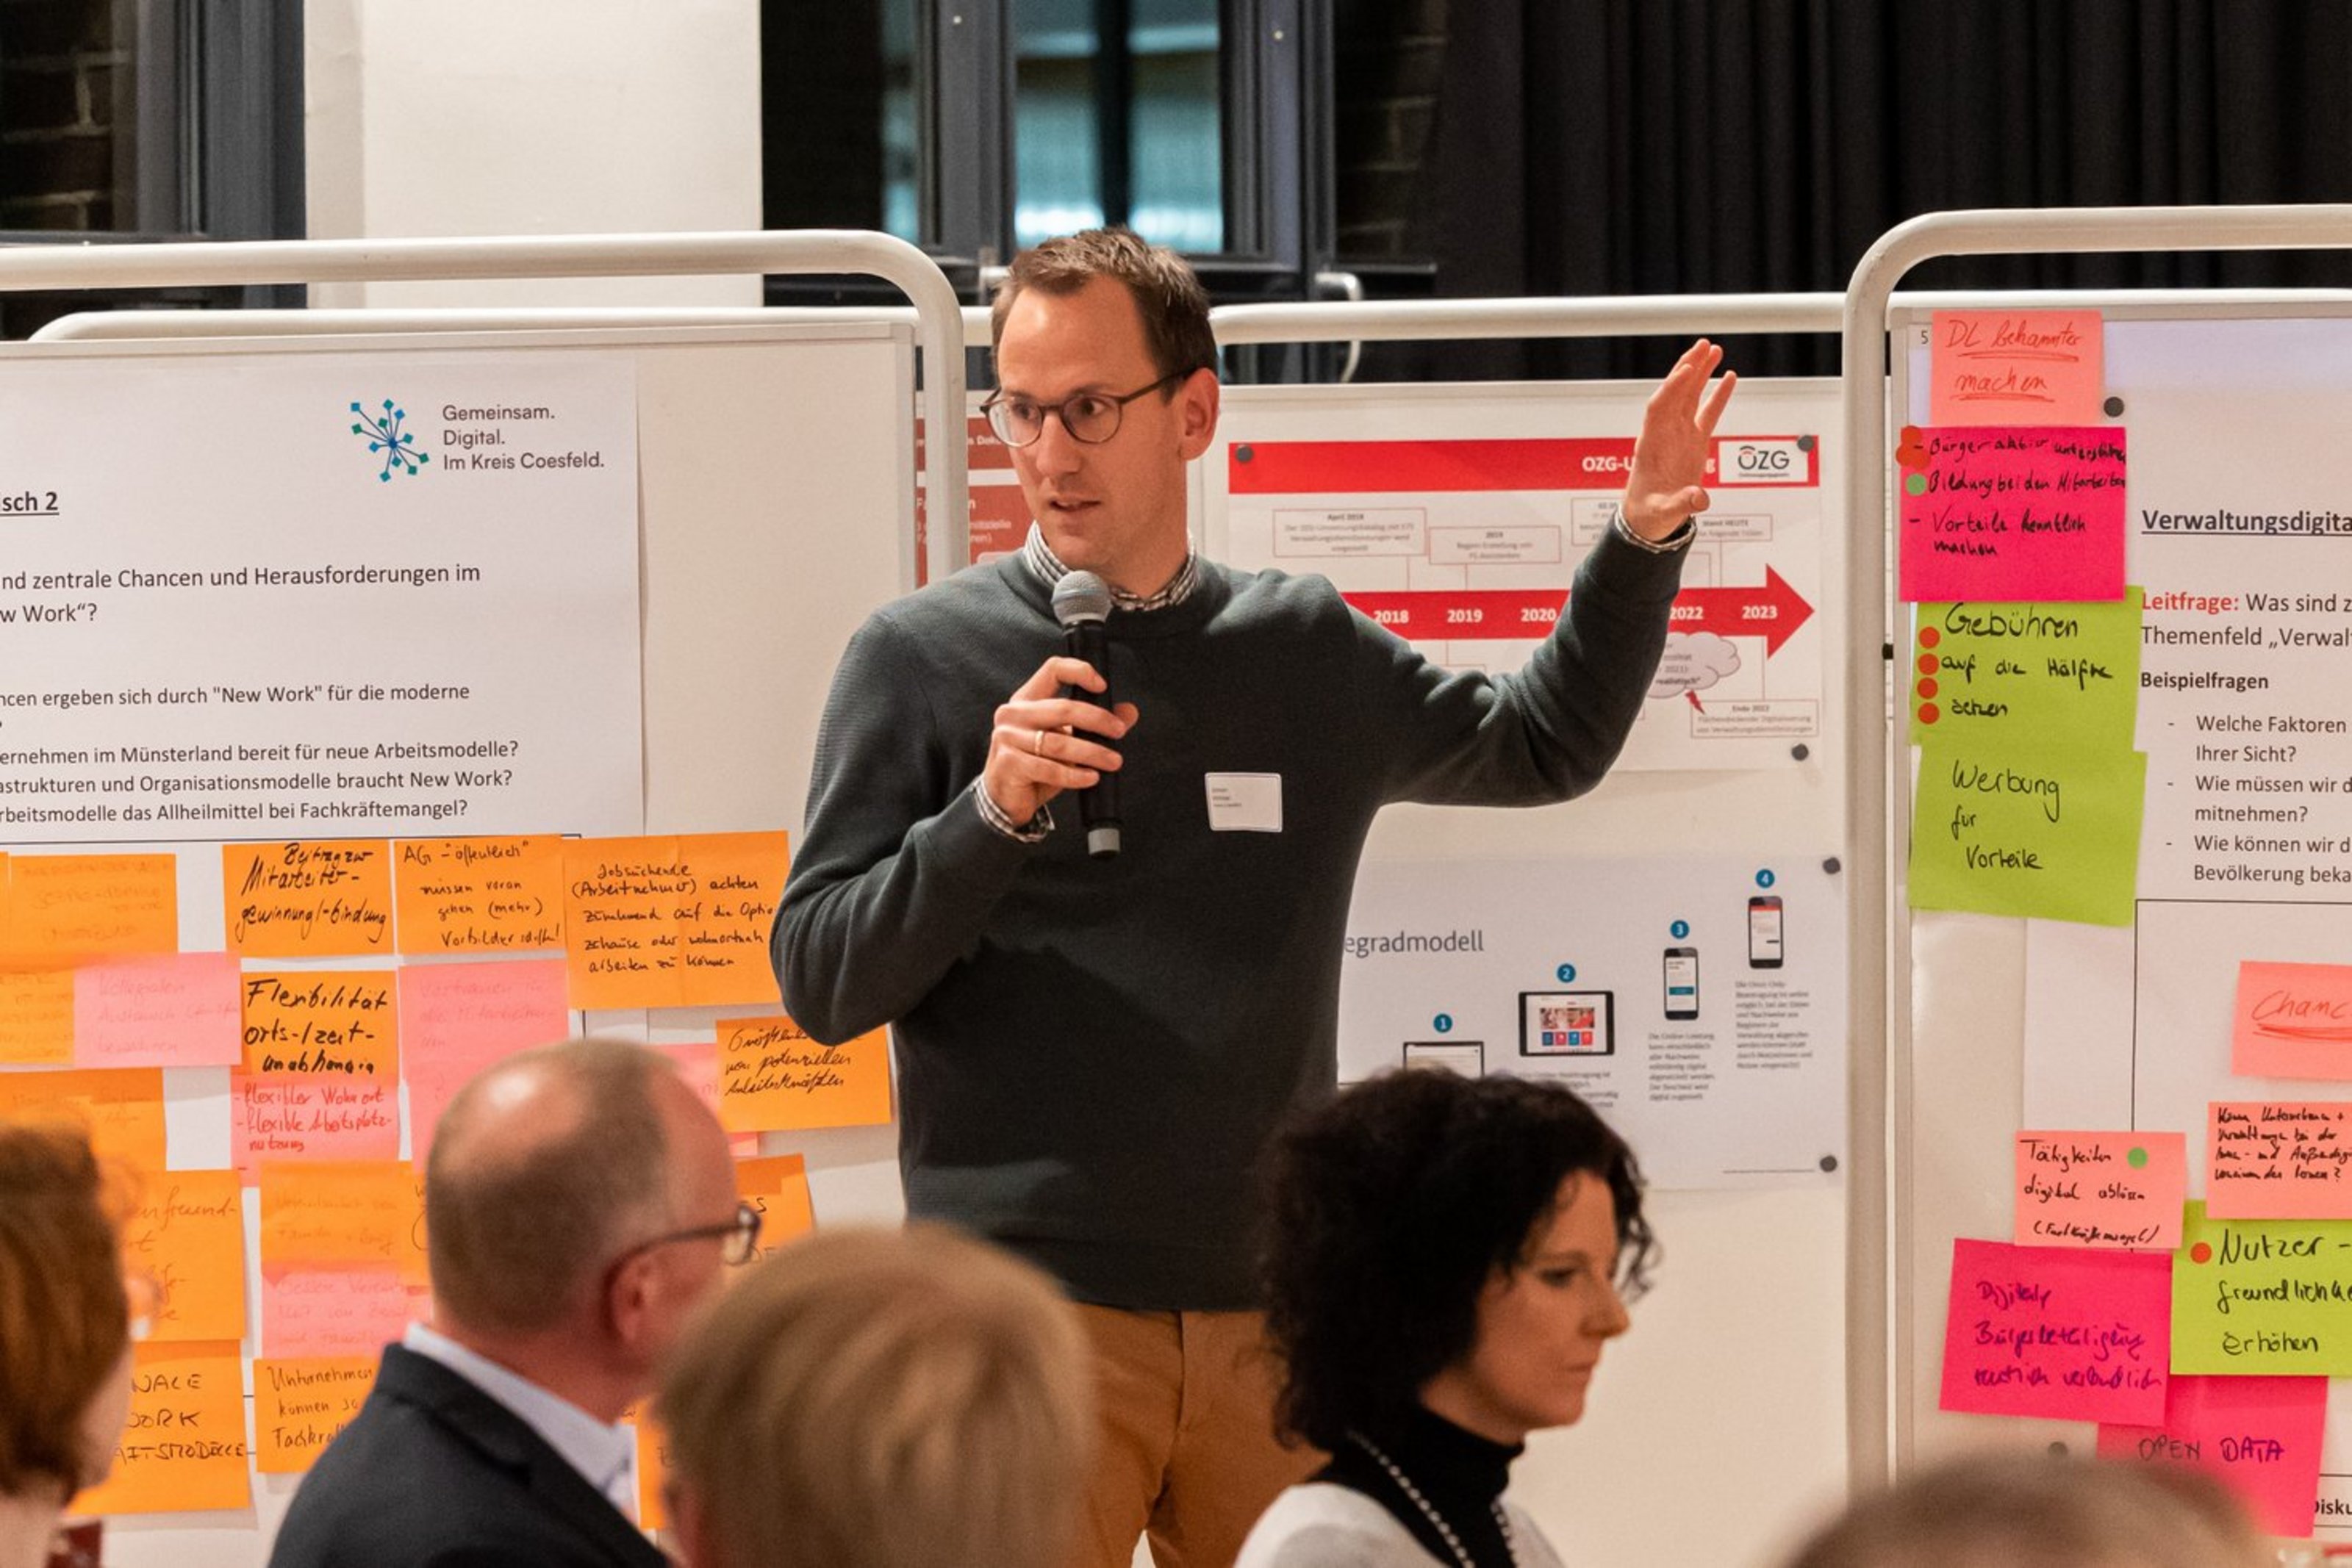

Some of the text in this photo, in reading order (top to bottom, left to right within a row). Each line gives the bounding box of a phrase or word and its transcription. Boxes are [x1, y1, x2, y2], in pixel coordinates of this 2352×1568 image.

[1921, 330, 1929, 345] 5
[1946, 320, 1981, 348] DL
[1954, 366, 2048, 392] machen
[442, 404, 556, 421] Gemeinsam.
[443, 429, 506, 450] Digital.
[444, 450, 605, 470] Im Kreis Coesfeld.
[1, 491, 59, 512] sch 2
[2142, 510, 2352, 536] Verwaltungsdigita
[2, 563, 481, 590] nd zentrale Chancen und Herausforderungen im
[2142, 591, 2240, 614] Leitfrage:
[2245, 593, 2290, 612] Was
[2295, 593, 2337, 612] sind
[1374, 605, 1778, 625] 2018 2019 2020 2022 2023
[1945, 603, 2079, 639] Gebühren
[2142, 625, 2262, 646] Themenfeld
[2140, 670, 2269, 692] Beispielfragen
[43, 689, 113, 710] ergeben
[119, 688, 152, 705] sich
[157, 687, 208, 705] durch
[213, 686, 260, 703] "New
[267, 685, 323, 703] Work"
[328, 685, 354, 702] für
[358, 684, 385, 701] die
[391, 684, 470, 701] moderne
[2196, 715, 2347, 734] Welche Faktoren
[0, 740, 519, 765] ernehmen im Münsterland bereit für neue Arbeitsmodelle?
[2195, 745, 2297, 763] Ihrer Sicht?
[102, 775, 135, 793] und
[140, 773, 331, 796] Organisationsmodelle
[337, 772, 404, 789] braucht
[410, 771, 450, 788] New
[455, 769, 513, 788] Work?
[1952, 759, 2060, 823] Werbung
[2195, 775, 2230, 792] Wie
[2236, 775, 2303, 793] müssen
[2309, 777, 2338, 793] wir
[0, 799, 469, 823] rbeitsmodelle das Allheilmittel bei Fachkräftemangel?
[2194, 805, 2309, 822] mitnehmen?
[2194, 835, 2229, 852] Wie
[2234, 835, 2301, 852] können
[2306, 837, 2334, 853] wir
[1965, 844, 2044, 870] Vorteile
[2193, 864, 2352, 886] Bevölkerung beka
[739, 902, 776, 921] Optio
[1344, 929, 1484, 959] egradmodell
[2138, 1434, 2285, 1464] OPEN DATA
